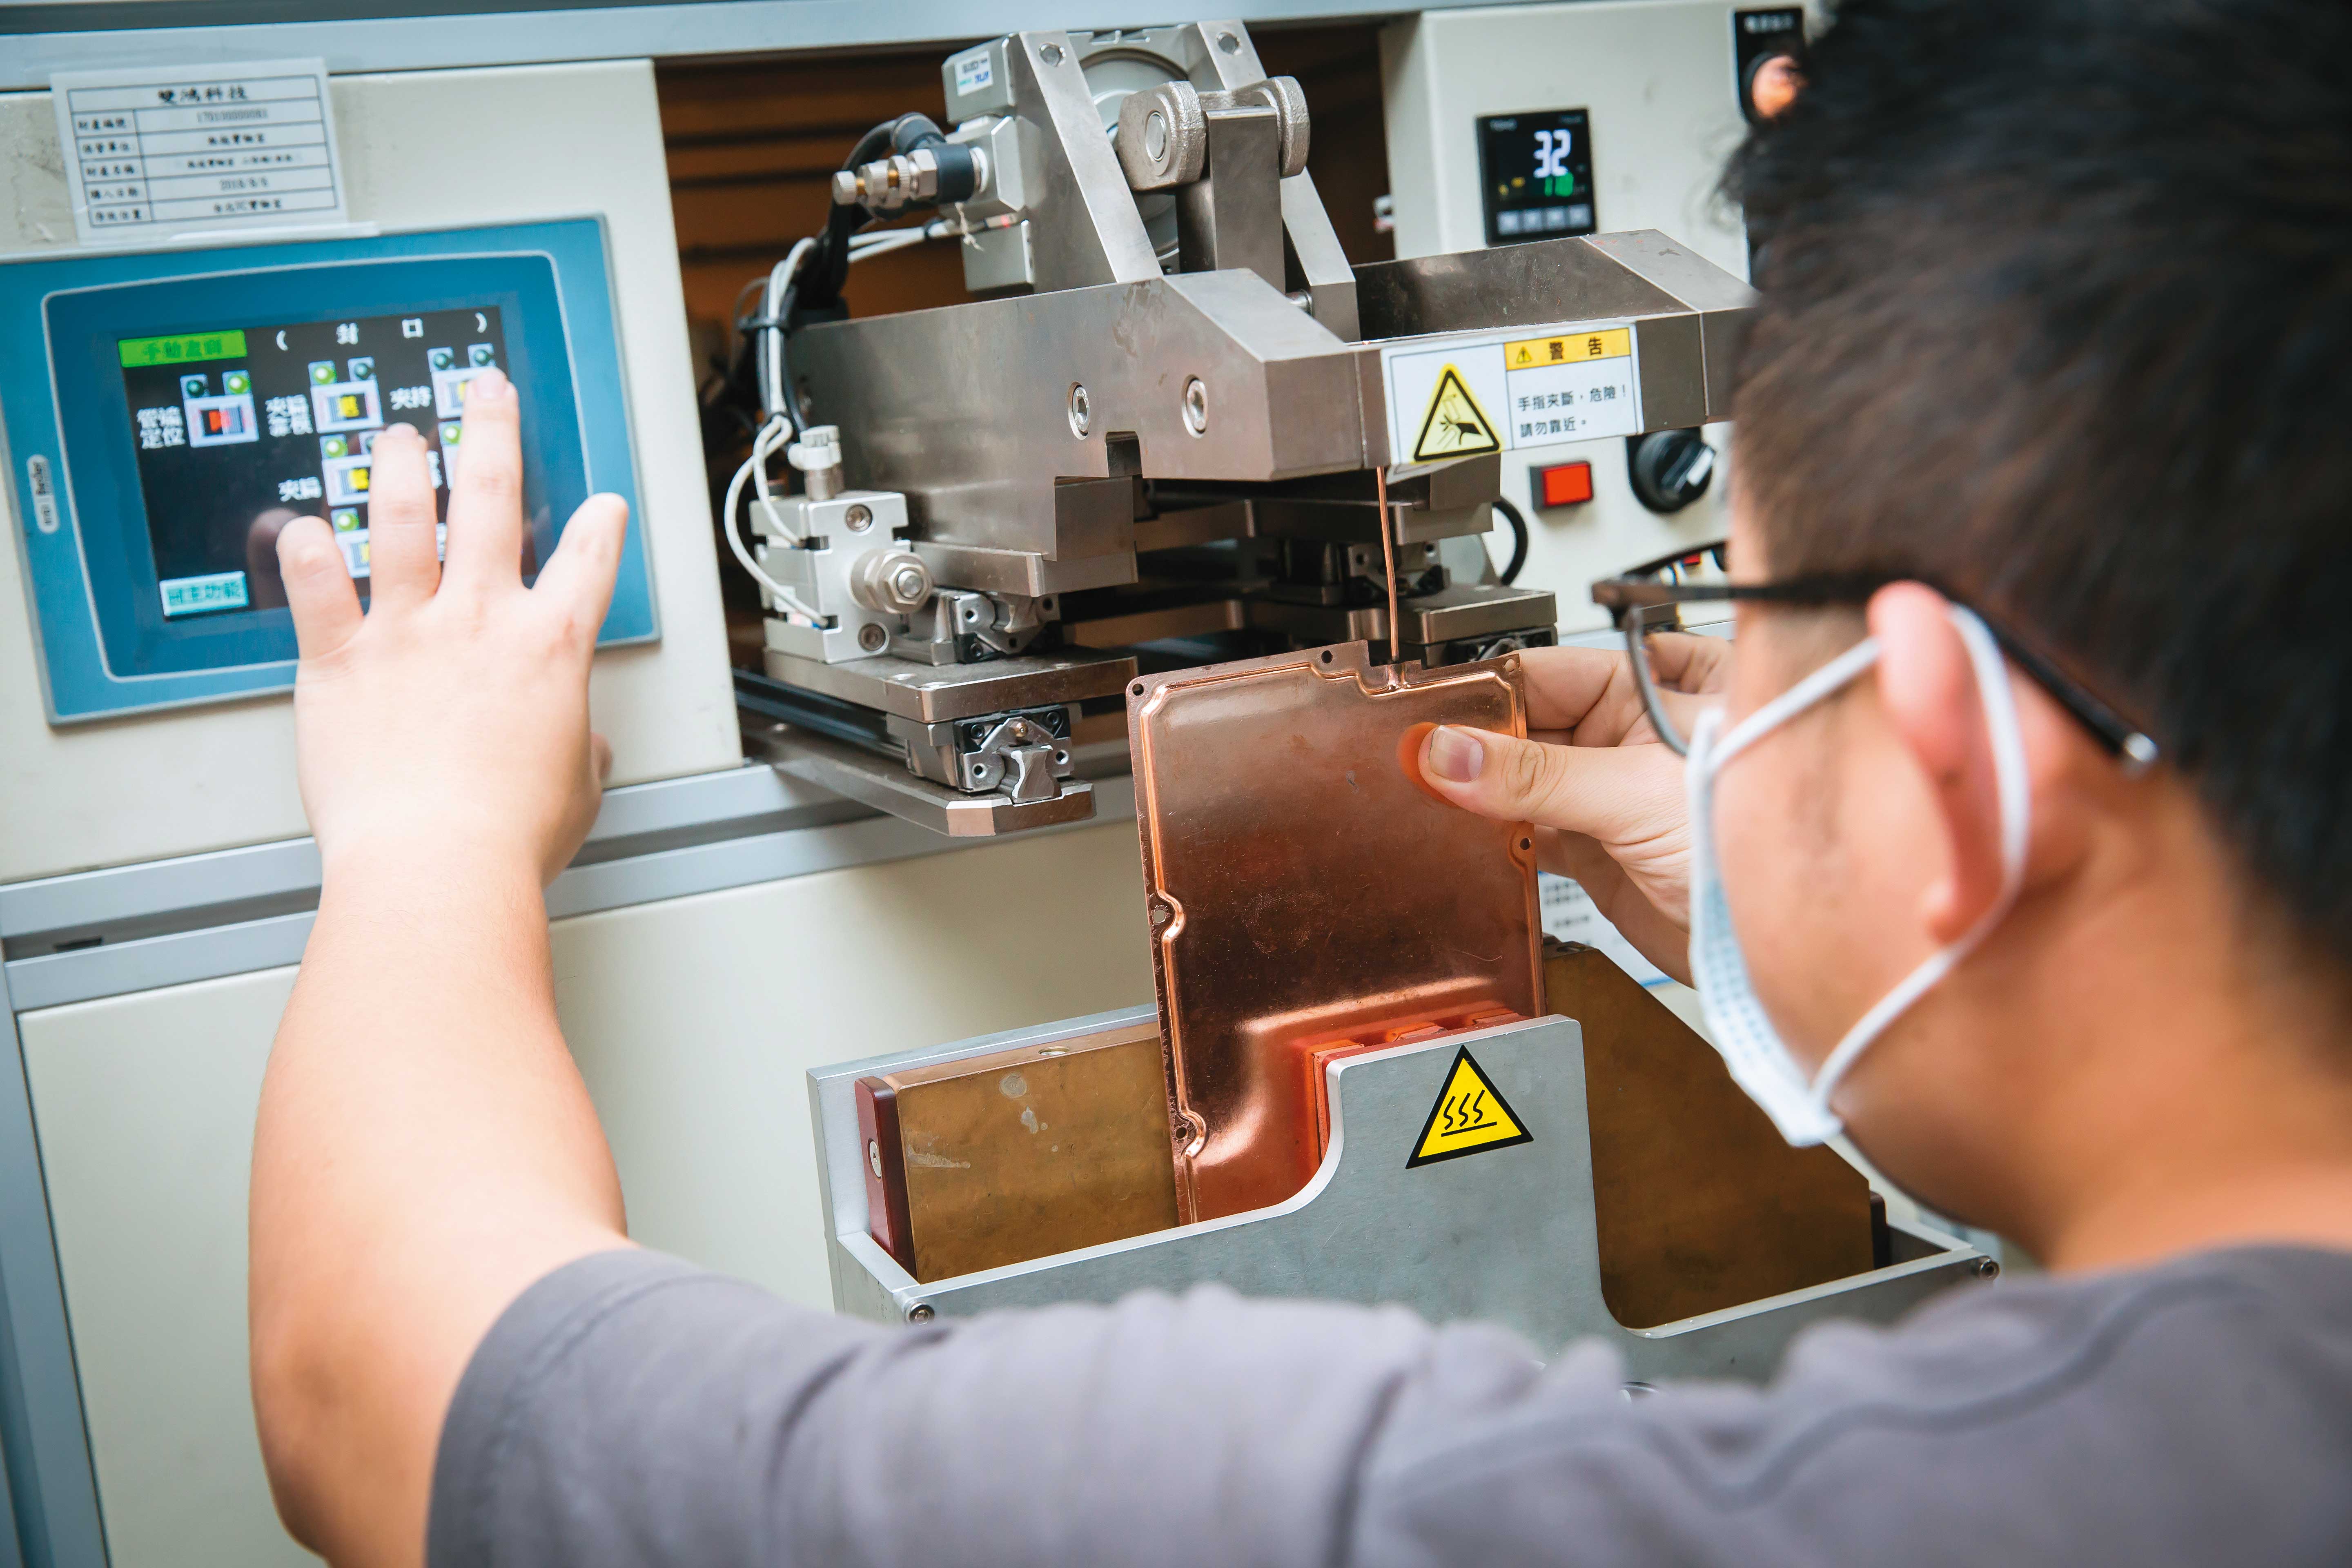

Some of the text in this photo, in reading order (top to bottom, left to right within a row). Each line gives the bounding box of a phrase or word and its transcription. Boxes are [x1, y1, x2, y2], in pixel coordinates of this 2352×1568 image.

[1533, 129, 1572, 179] 32
[1548, 336, 1602, 361] 警告
[140, 427, 186, 449] 定位
